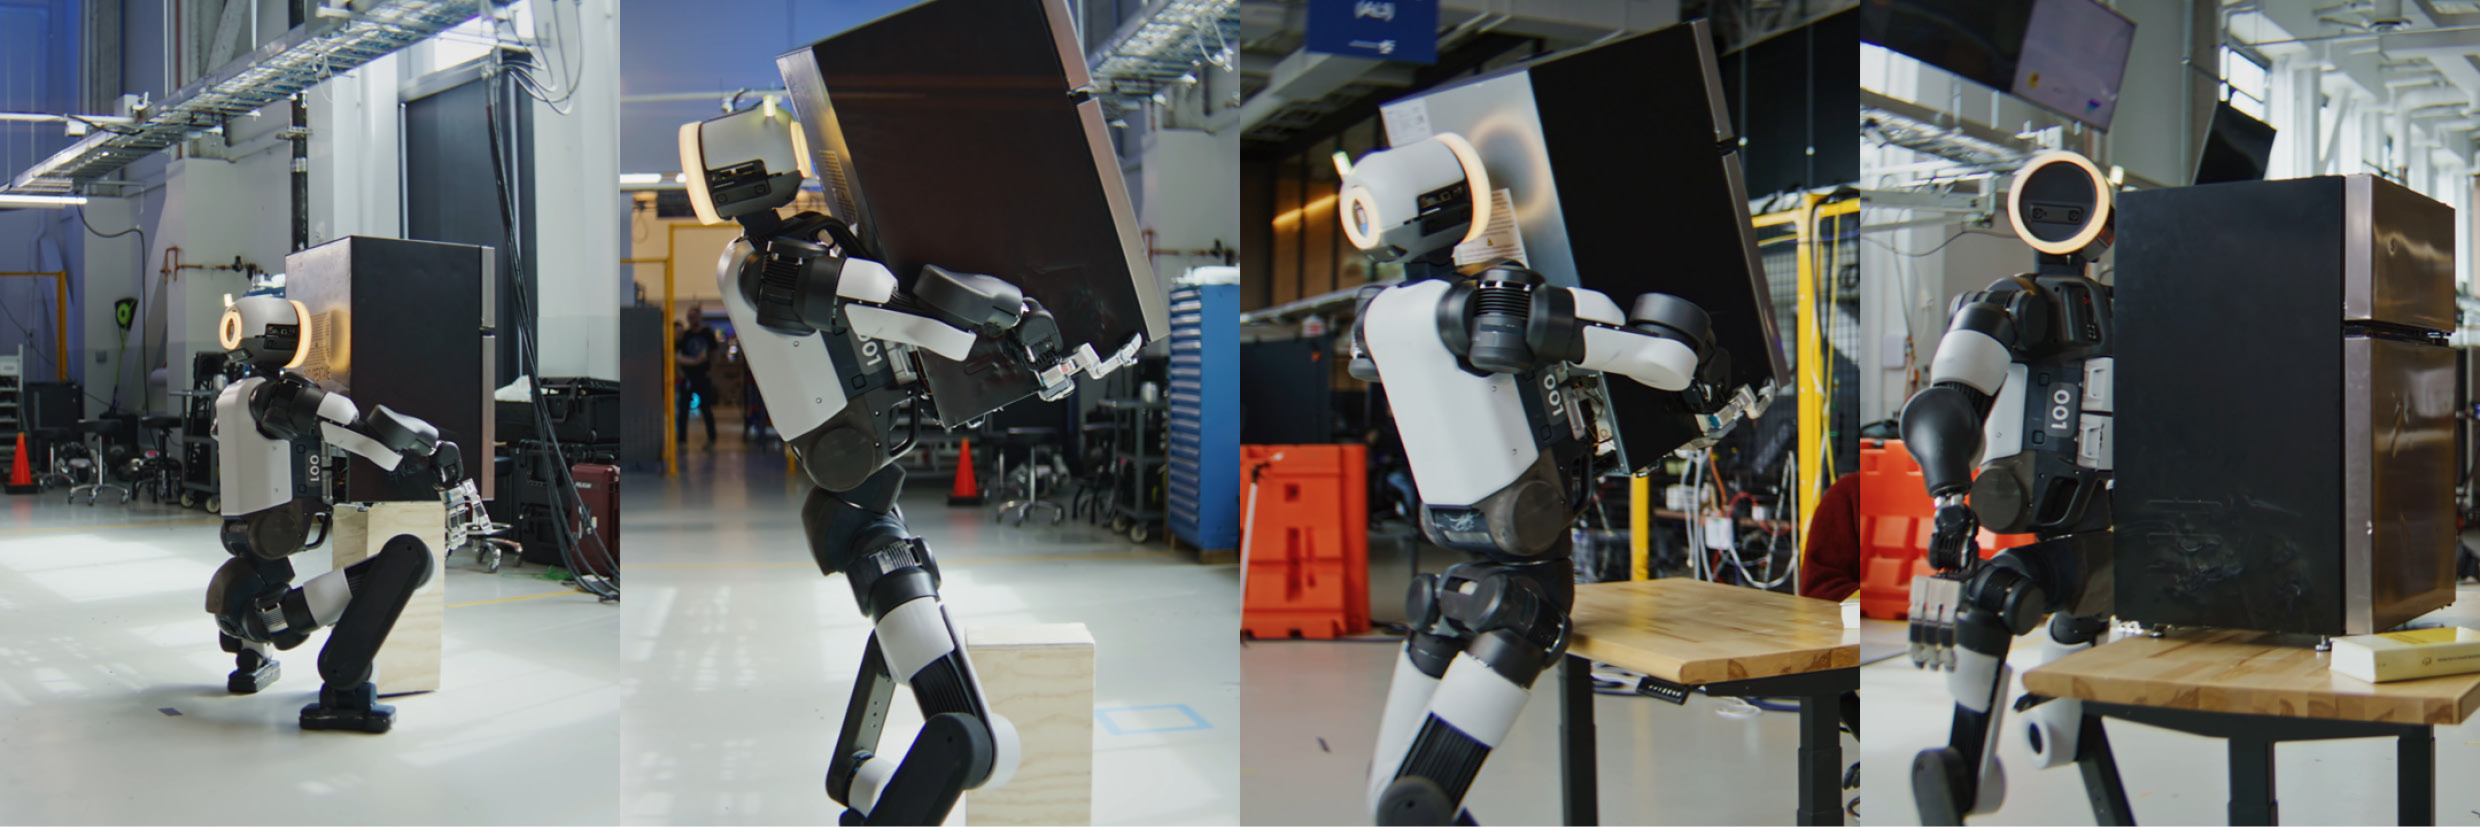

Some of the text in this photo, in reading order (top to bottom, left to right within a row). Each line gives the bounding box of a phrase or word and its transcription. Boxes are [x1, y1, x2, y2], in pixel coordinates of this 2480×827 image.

[1543, 373, 1564, 416] 001
[2051, 389, 2070, 429] 001
[309, 454, 320, 481] 001
